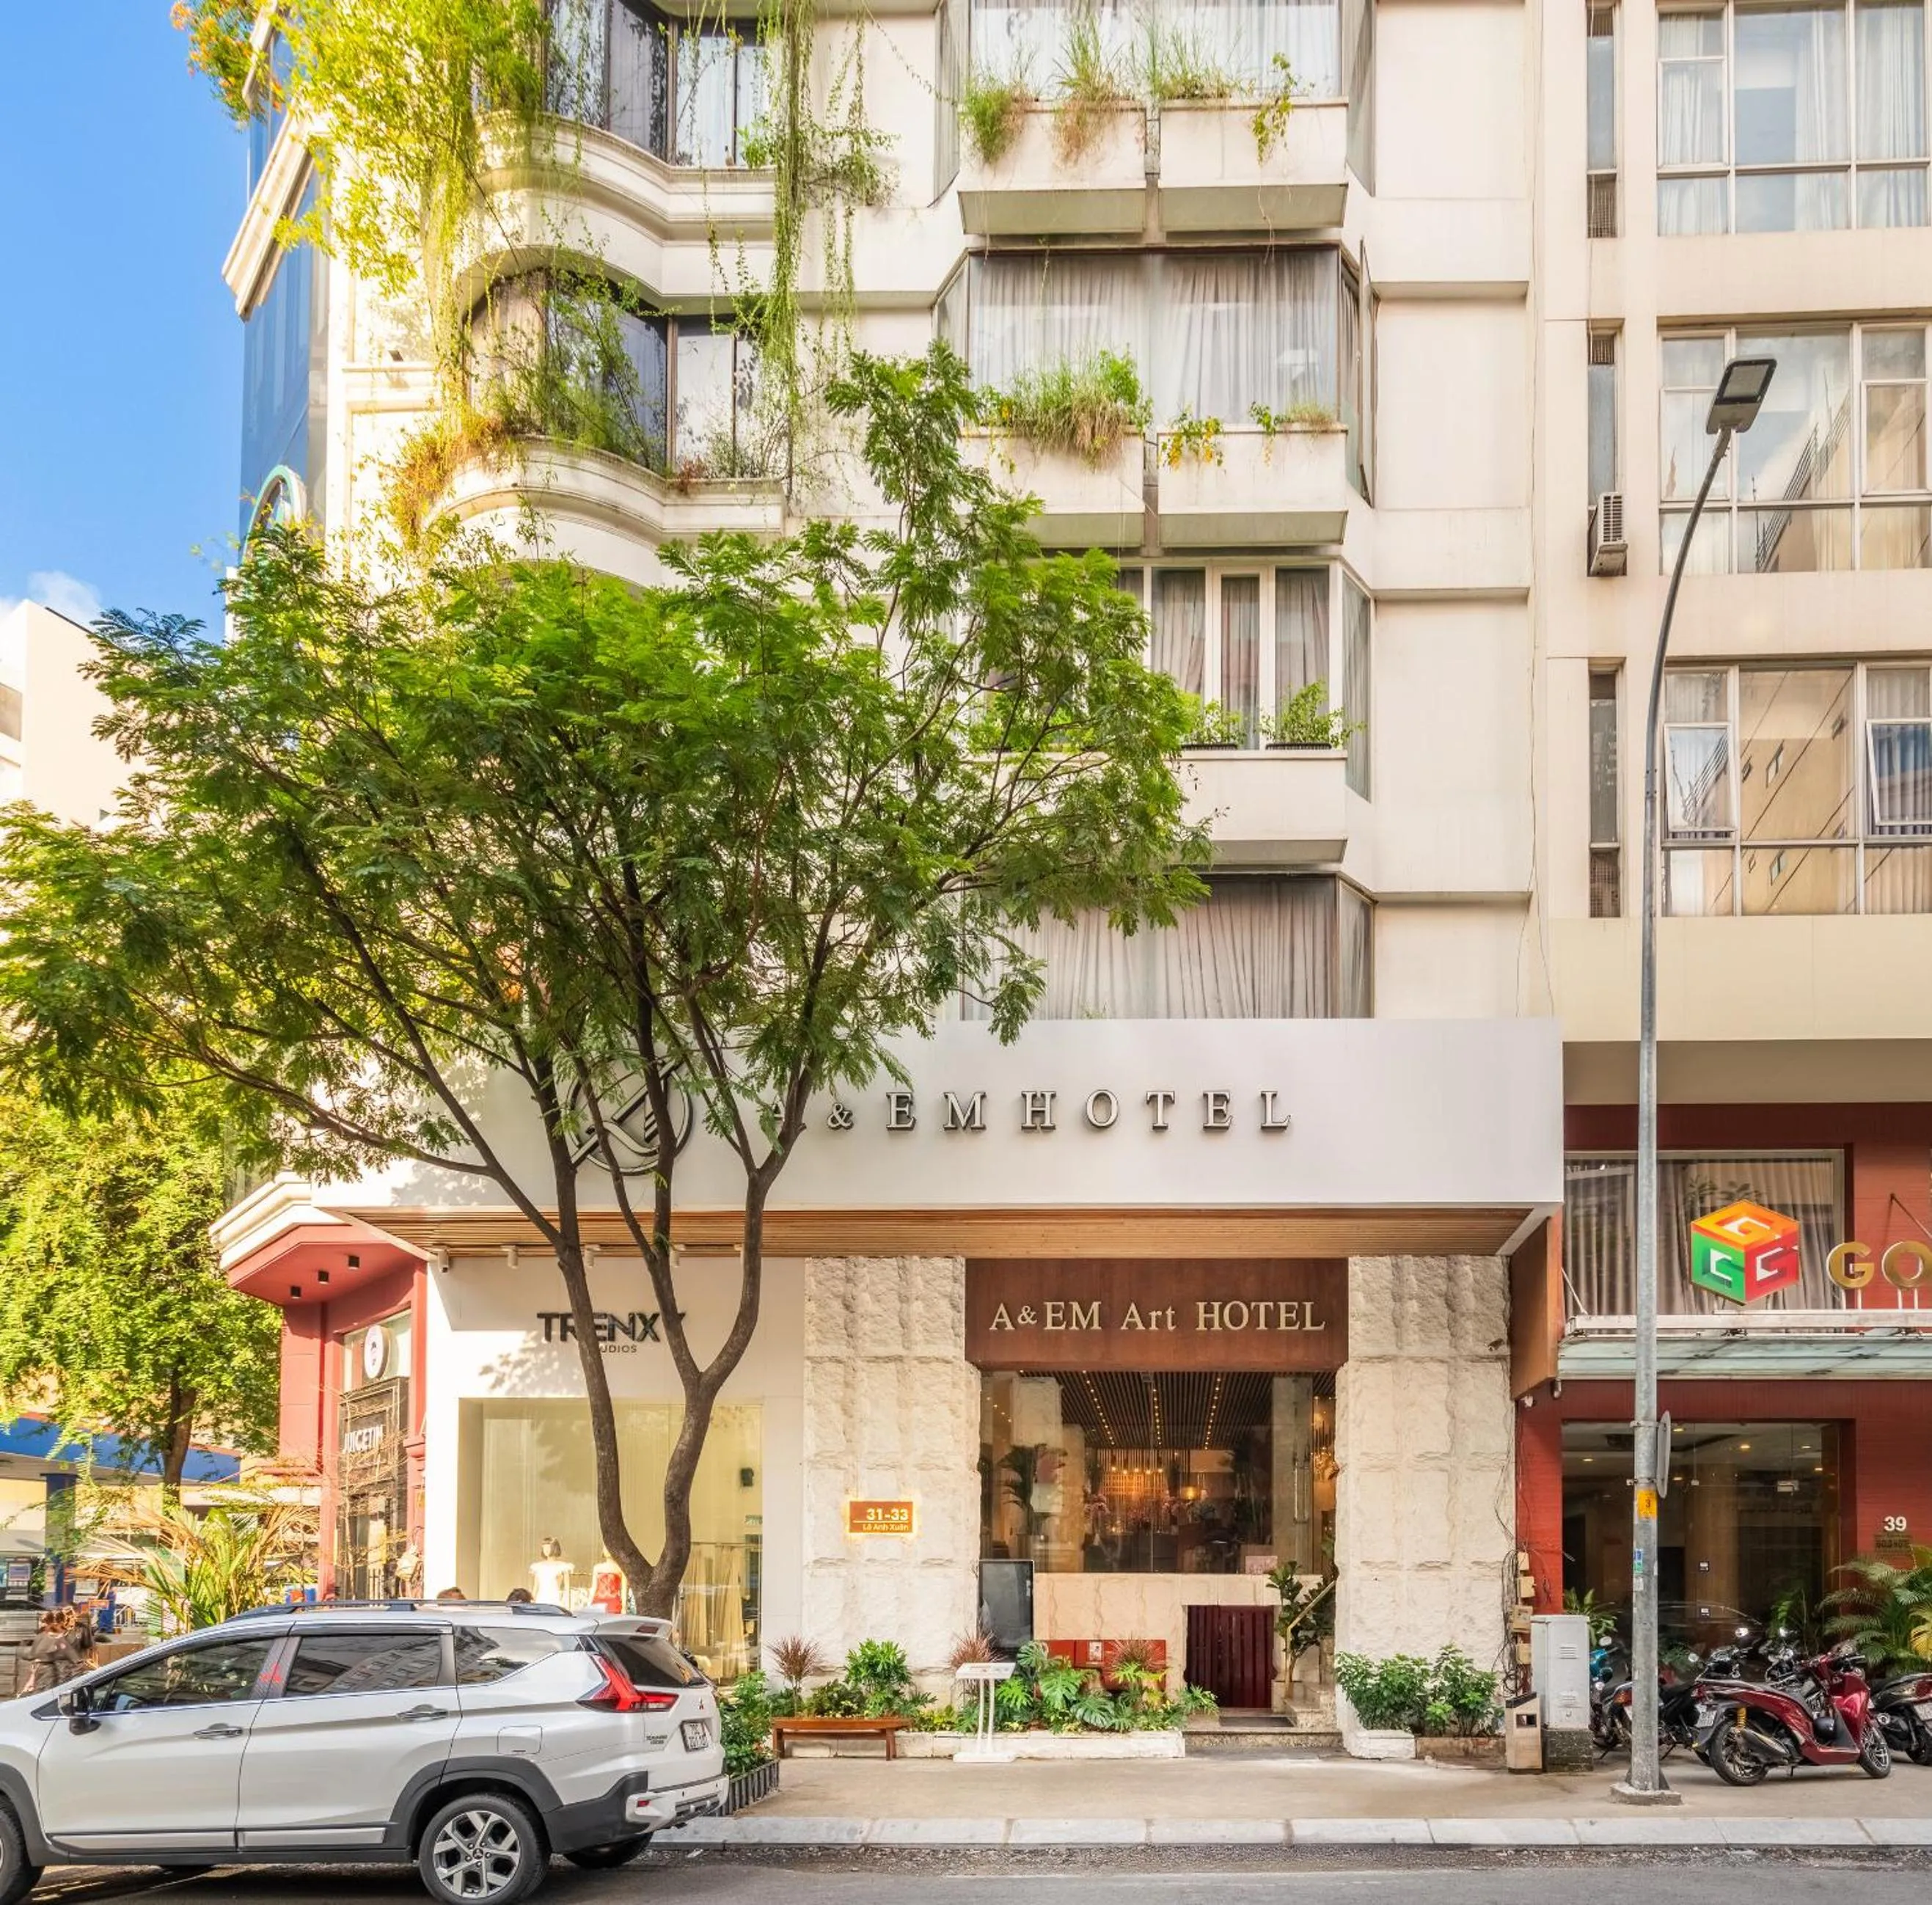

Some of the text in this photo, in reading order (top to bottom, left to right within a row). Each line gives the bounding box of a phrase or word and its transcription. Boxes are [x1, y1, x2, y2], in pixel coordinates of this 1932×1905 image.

[1020, 1089, 1292, 1130] HOTEL
[1826, 1240, 1932, 1289] GO
[537, 1311, 687, 1342] TRENX
[989, 1300, 1326, 1331] A&EM Art HOTEL
[866, 1508, 909, 1521] 31-33
[1883, 1515, 1908, 1532] 39
